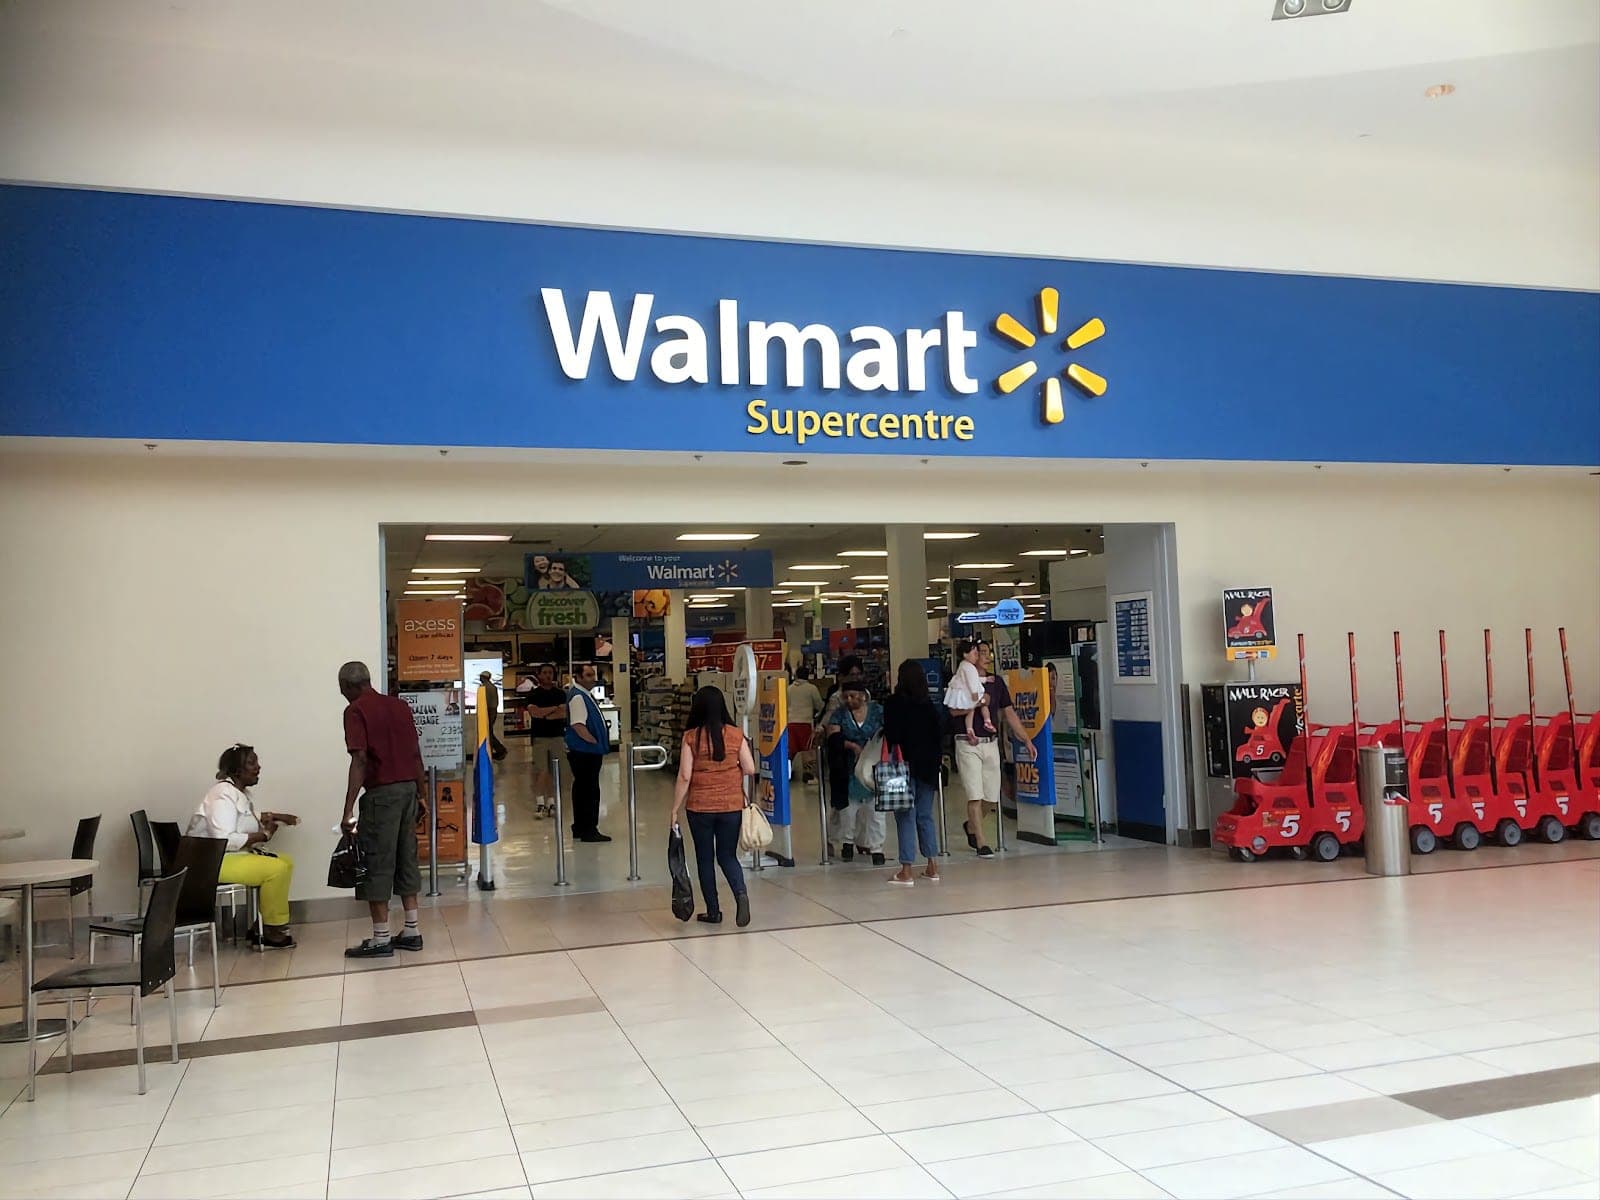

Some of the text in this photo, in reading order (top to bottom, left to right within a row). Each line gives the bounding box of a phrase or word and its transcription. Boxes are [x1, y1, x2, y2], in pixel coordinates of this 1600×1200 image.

[540, 287, 979, 394] Walmart
[746, 399, 975, 444] Supercentre
[647, 564, 714, 580] Walmart
[538, 595, 587, 607] discover
[1225, 590, 1272, 600] MALL RACER
[404, 618, 456, 632] axess
[538, 607, 588, 626] fresh
[1015, 691, 1038, 706] new
[1229, 687, 1290, 701] MALL RACER
[1256, 744, 1265, 756] 5
[1428, 803, 1444, 824] 5
[1471, 802, 1486, 821] 5
[1513, 799, 1528, 818] 5
[1555, 796, 1570, 815] 5
[1280, 814, 1301, 838] 5
[1335, 811, 1352, 833] 5
